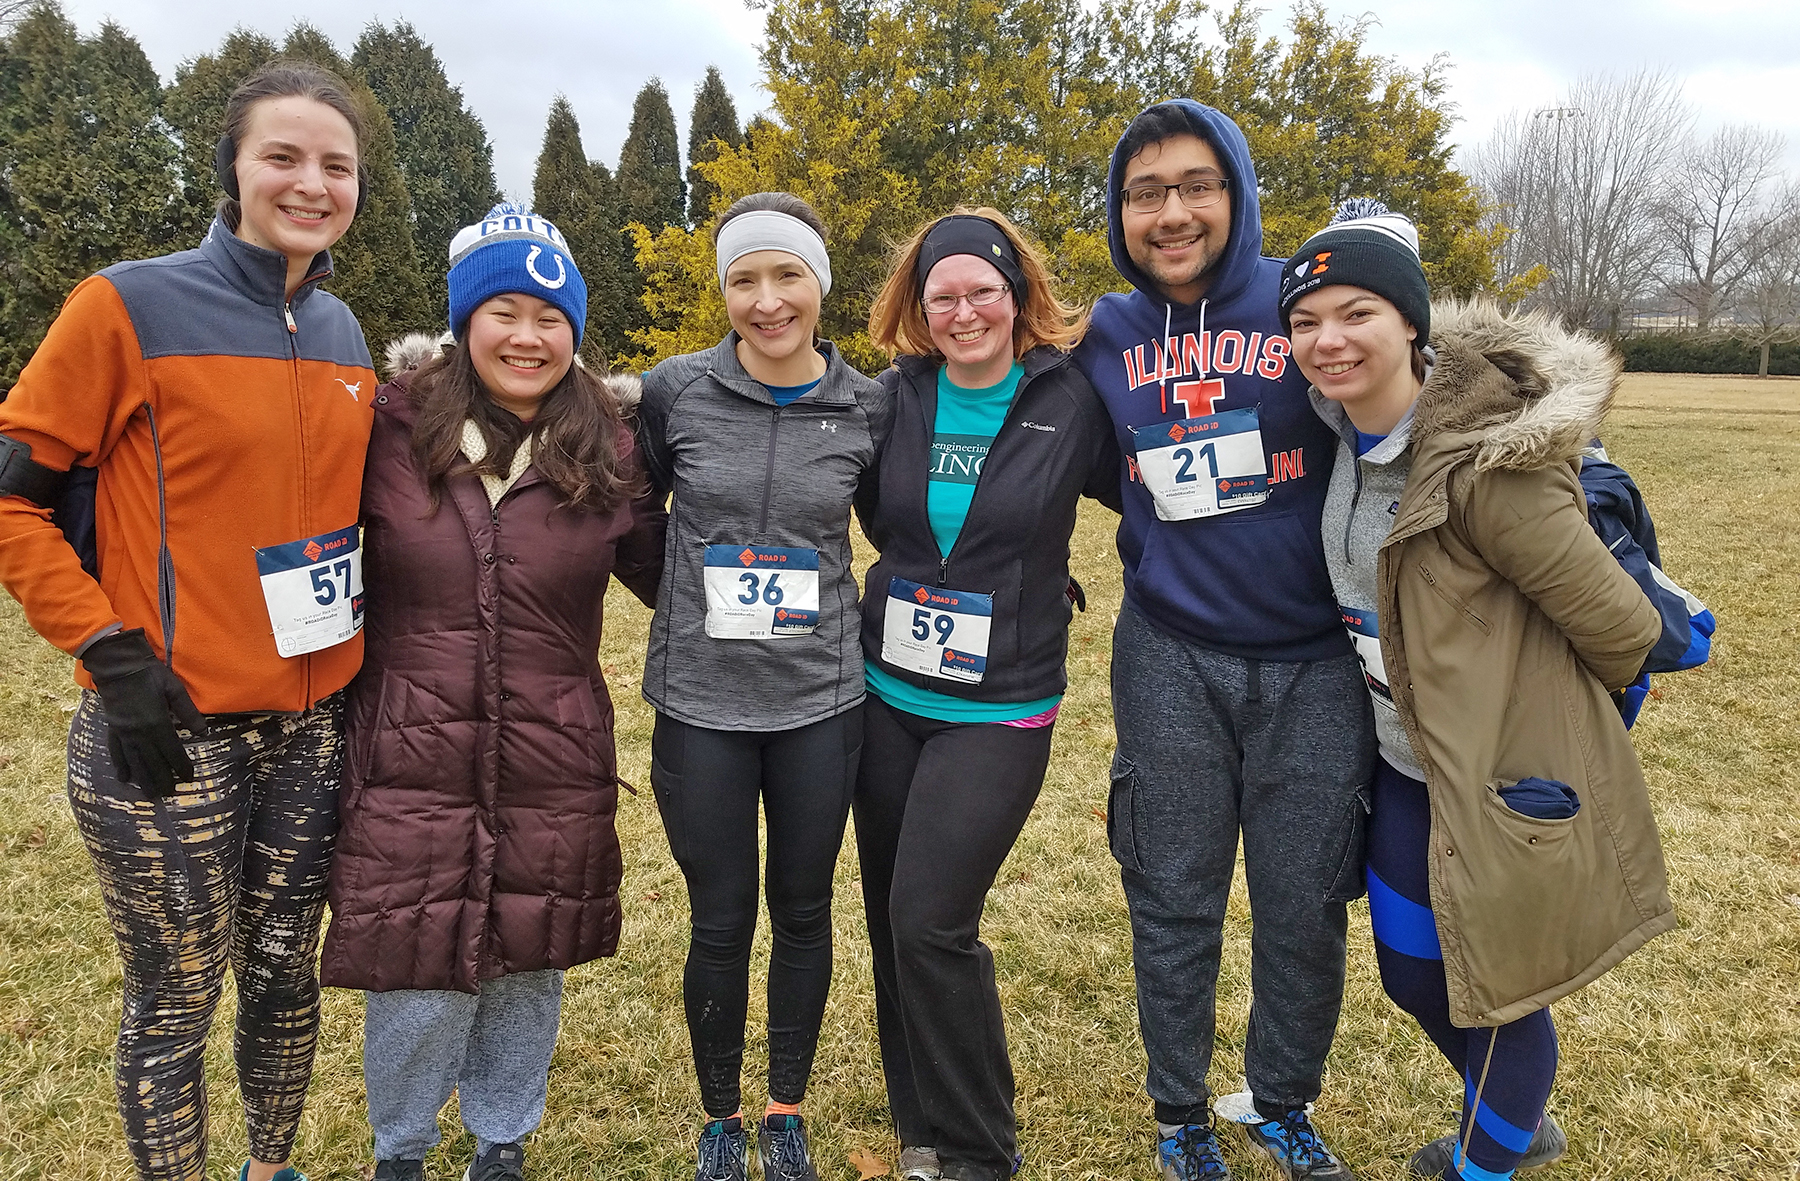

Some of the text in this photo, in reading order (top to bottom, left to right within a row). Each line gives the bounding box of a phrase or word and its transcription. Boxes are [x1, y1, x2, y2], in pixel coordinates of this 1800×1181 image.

[1122, 329, 1292, 392] ILLINOIS
[1028, 421, 1056, 433] Columbia
[1188, 422, 1209, 434] ROAD
[1172, 442, 1219, 484] 21
[324, 539, 342, 552] ROAD
[758, 553, 779, 562] ROAD
[309, 558, 351, 606] 57
[737, 572, 784, 606] 36
[931, 594, 950, 605] ROAD
[912, 608, 955, 646] 59
